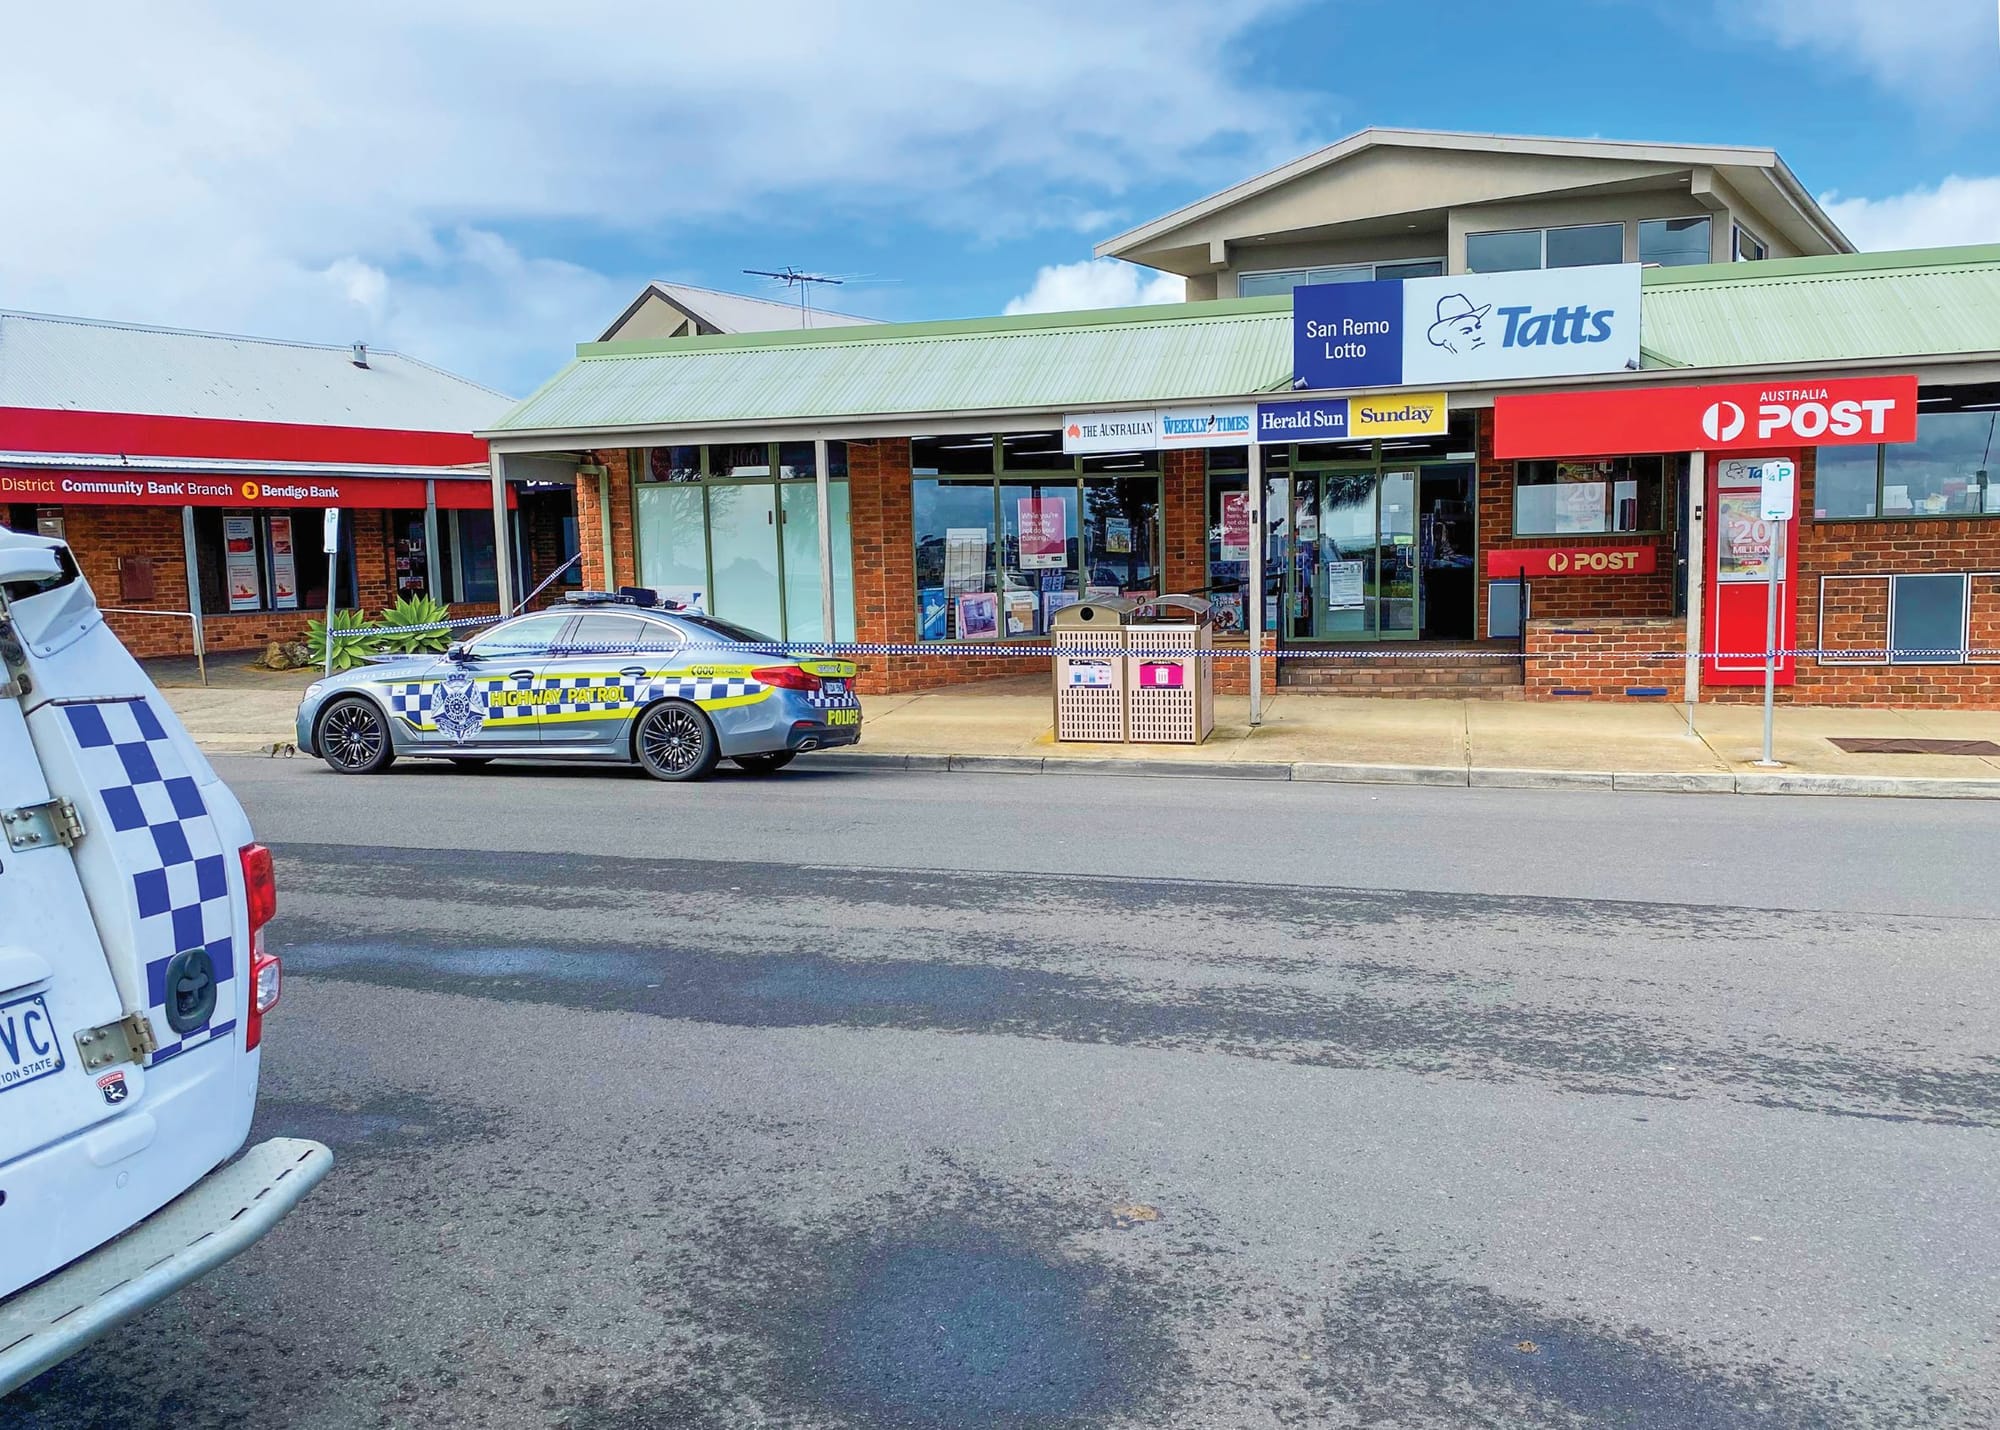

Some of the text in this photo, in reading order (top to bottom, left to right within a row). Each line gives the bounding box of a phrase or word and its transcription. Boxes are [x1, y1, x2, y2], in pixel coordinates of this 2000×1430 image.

[1306, 317, 1389, 338] San Remo
[1497, 304, 1614, 348] Tatts
[1325, 342, 1366, 359] Lotto
[1760, 388, 1828, 402] AUSTRALIA
[1261, 409, 1344, 430] Herald Sun
[1360, 405, 1434, 424] Sunday
[1758, 399, 1895, 439] POST
[1083, 421, 1153, 438] THE AUSTRALIAN
[1163, 415, 1249, 435] WEEKLY TIMES
[1779, 467, 1791, 482] P
[1, 477, 56, 492] District
[61, 479, 143, 497] Community
[187, 482, 233, 496] Branch
[261, 484, 308, 500] Bendigo
[310, 485, 339, 498] Bank
[1574, 551, 1639, 571] POST
[491, 686, 628, 707] HIGHWAY PATROL
[828, 709, 859, 726] POLICE
[0, 1057, 52, 1085] ION STATE
